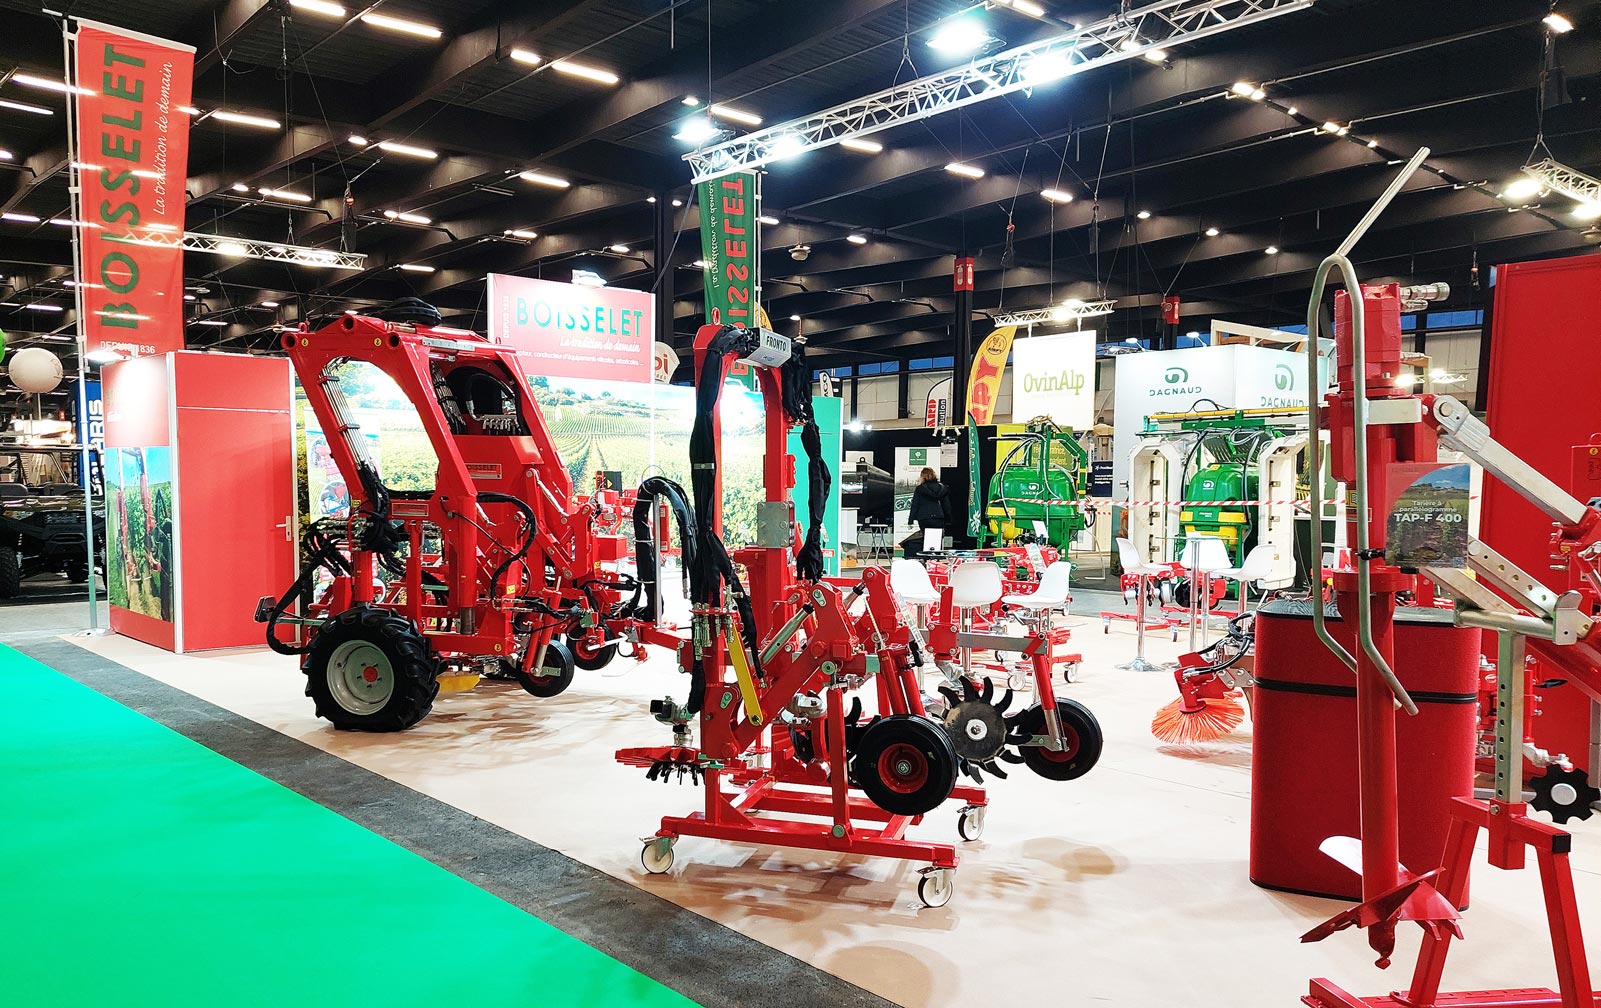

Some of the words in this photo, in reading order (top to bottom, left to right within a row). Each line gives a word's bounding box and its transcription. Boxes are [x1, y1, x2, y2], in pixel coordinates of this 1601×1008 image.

[158, 61, 173, 110] demain
[157, 113, 169, 132] de
[153, 136, 171, 195] tradition
[100, 44, 146, 329] BOISSELET
[153, 196, 165, 216] La
[516, 297, 643, 337] BOISSELET
[604, 337, 614, 351] de
[614, 338, 641, 352] demain
[766, 335, 787, 352] FRONTO
[1023, 369, 1085, 395] OvinAlp
[1149, 386, 1202, 397] DAGNAUD
[1260, 396, 1305, 409] DAGNAUD
[1394, 513, 1433, 523] TAP-F
[1435, 513, 1463, 523] 400
